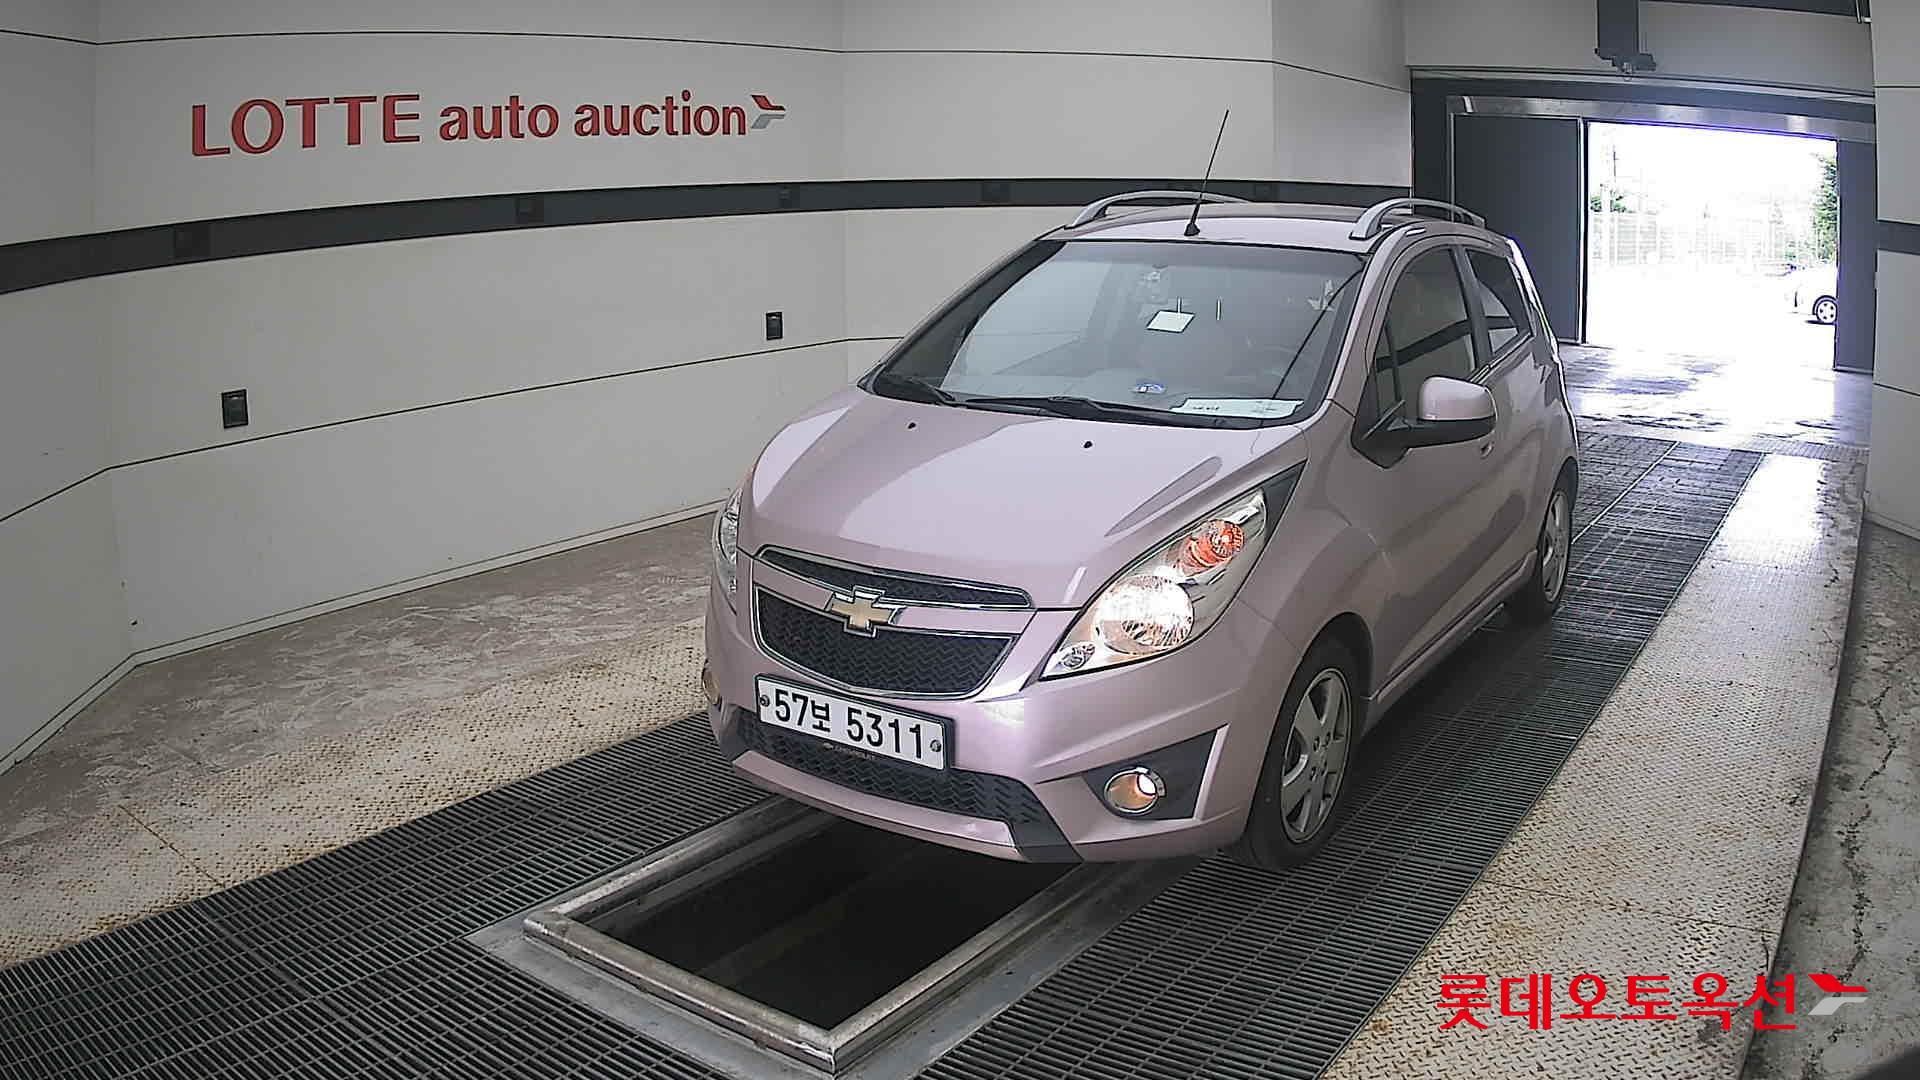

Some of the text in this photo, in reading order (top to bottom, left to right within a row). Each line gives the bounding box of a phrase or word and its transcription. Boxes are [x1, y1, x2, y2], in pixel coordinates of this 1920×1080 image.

[191, 89, 747, 157] LOTTE auto auction
[775, 688, 831, 733] 57보
[847, 709, 923, 760] 5311
